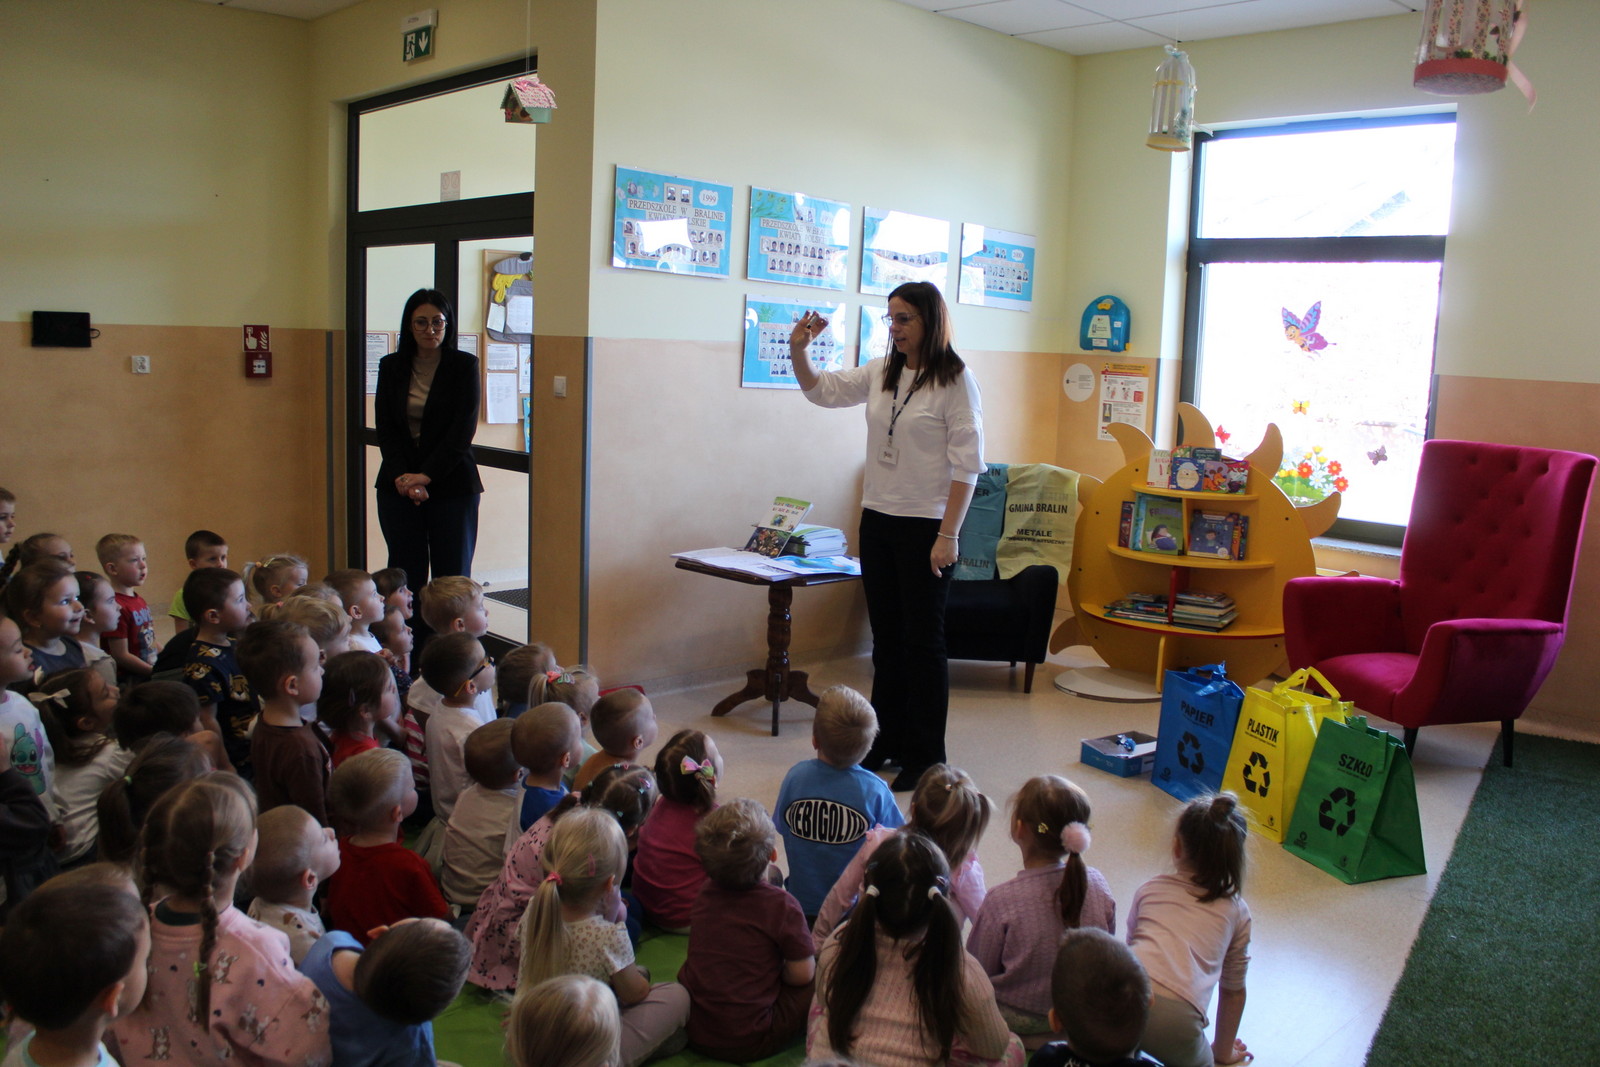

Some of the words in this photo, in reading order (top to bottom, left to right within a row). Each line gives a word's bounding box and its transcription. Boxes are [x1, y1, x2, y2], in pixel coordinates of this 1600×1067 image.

[702, 194, 717, 203] 1999
[629, 200, 677, 214] PRZEDSZKOLE
[681, 207, 688, 215] W
[694, 208, 724, 221] BRALINIE
[1008, 503, 1034, 513] GMINA
[1036, 503, 1068, 514] BRALIN
[1016, 528, 1052, 537] METALE
[1181, 700, 1214, 727] PAPIER
[1247, 717, 1279, 743] PLASTIK
[1338, 753, 1373, 778] SZKŁO
